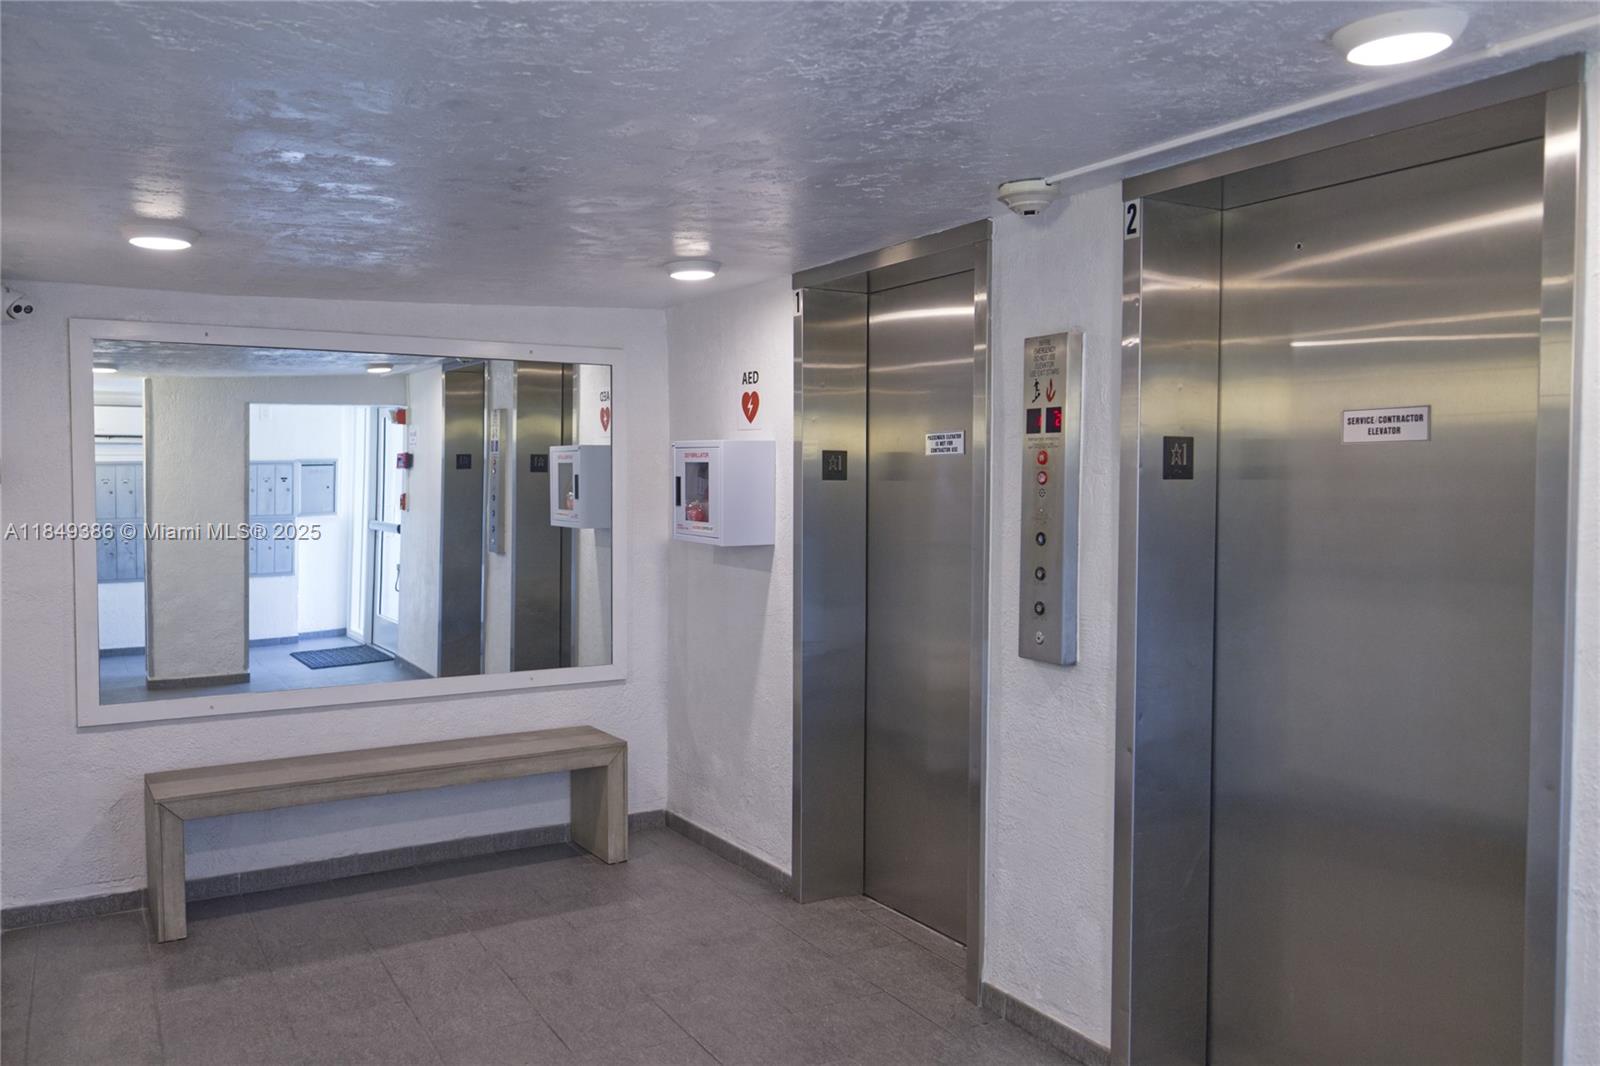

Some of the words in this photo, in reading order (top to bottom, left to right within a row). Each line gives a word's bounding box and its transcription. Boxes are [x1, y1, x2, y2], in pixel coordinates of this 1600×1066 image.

[1126, 203, 1137, 235] 2
[795, 291, 800, 313] 1
[742, 370, 759, 385] AED
[1367, 427, 1401, 435] ELEVATOR
